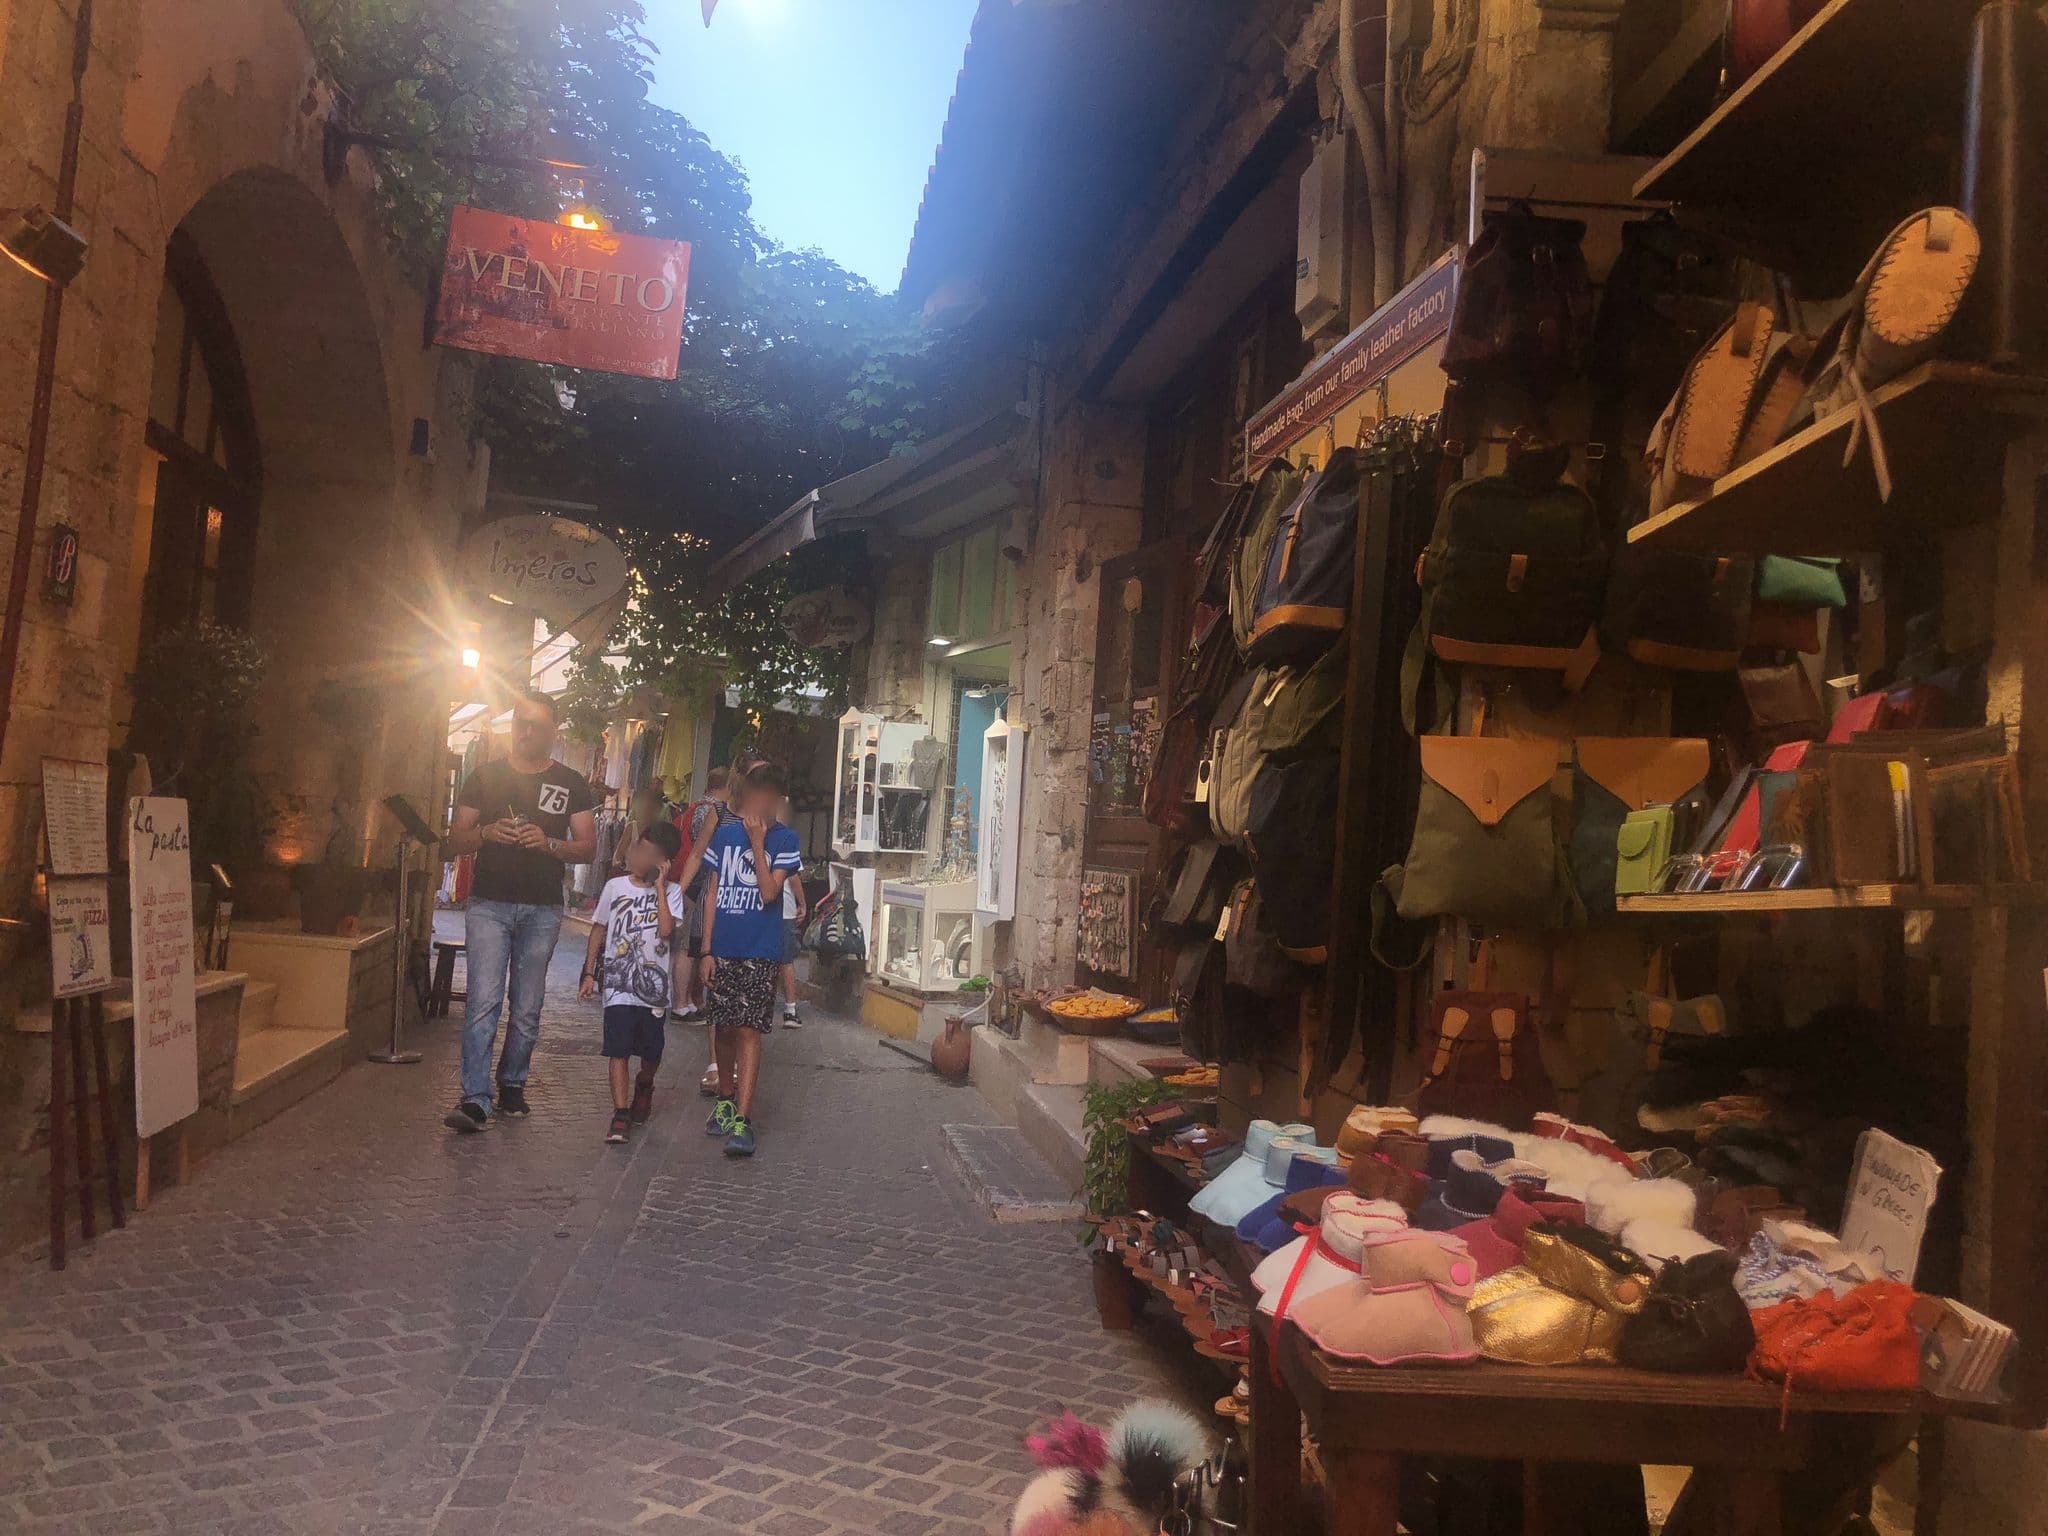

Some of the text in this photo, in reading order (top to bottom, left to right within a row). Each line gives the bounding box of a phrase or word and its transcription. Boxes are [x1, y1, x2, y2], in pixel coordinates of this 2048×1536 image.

[463, 247, 674, 313] VENETO
[1251, 286, 1446, 453] Handmade bags from our family leather factory
[134, 798, 153, 833] La
[540, 786, 569, 812] 75
[149, 823, 188, 860] pasta
